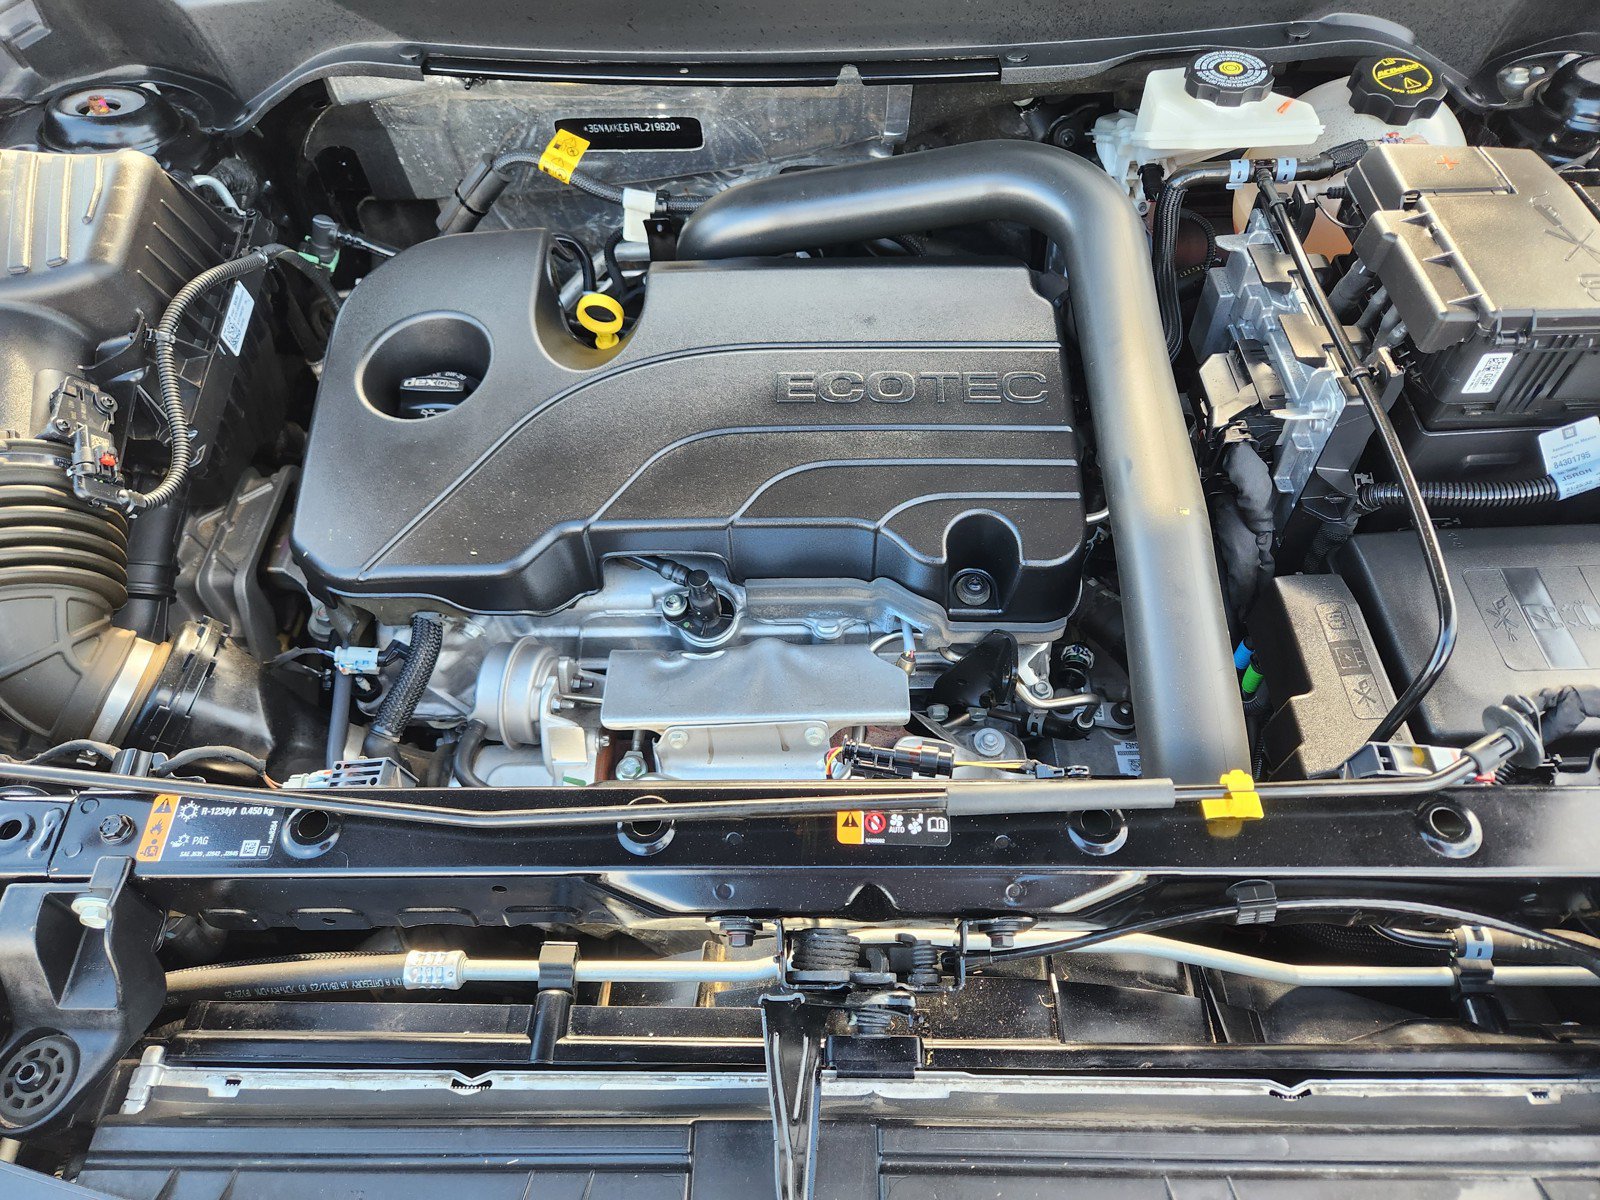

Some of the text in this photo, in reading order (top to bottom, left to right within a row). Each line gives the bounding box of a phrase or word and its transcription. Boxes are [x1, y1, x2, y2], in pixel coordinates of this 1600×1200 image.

[403, 378, 460, 388] dexos
[776, 371, 1049, 404] ECOTEC
[1553, 451, 1591, 469] 84301795
[201, 806, 275, 817] R-1234yf 0.450 kg
[889, 826, 906, 834] AUTO
[192, 836, 210, 845] PAG
[352, 979, 385, 989] CATEGORY
